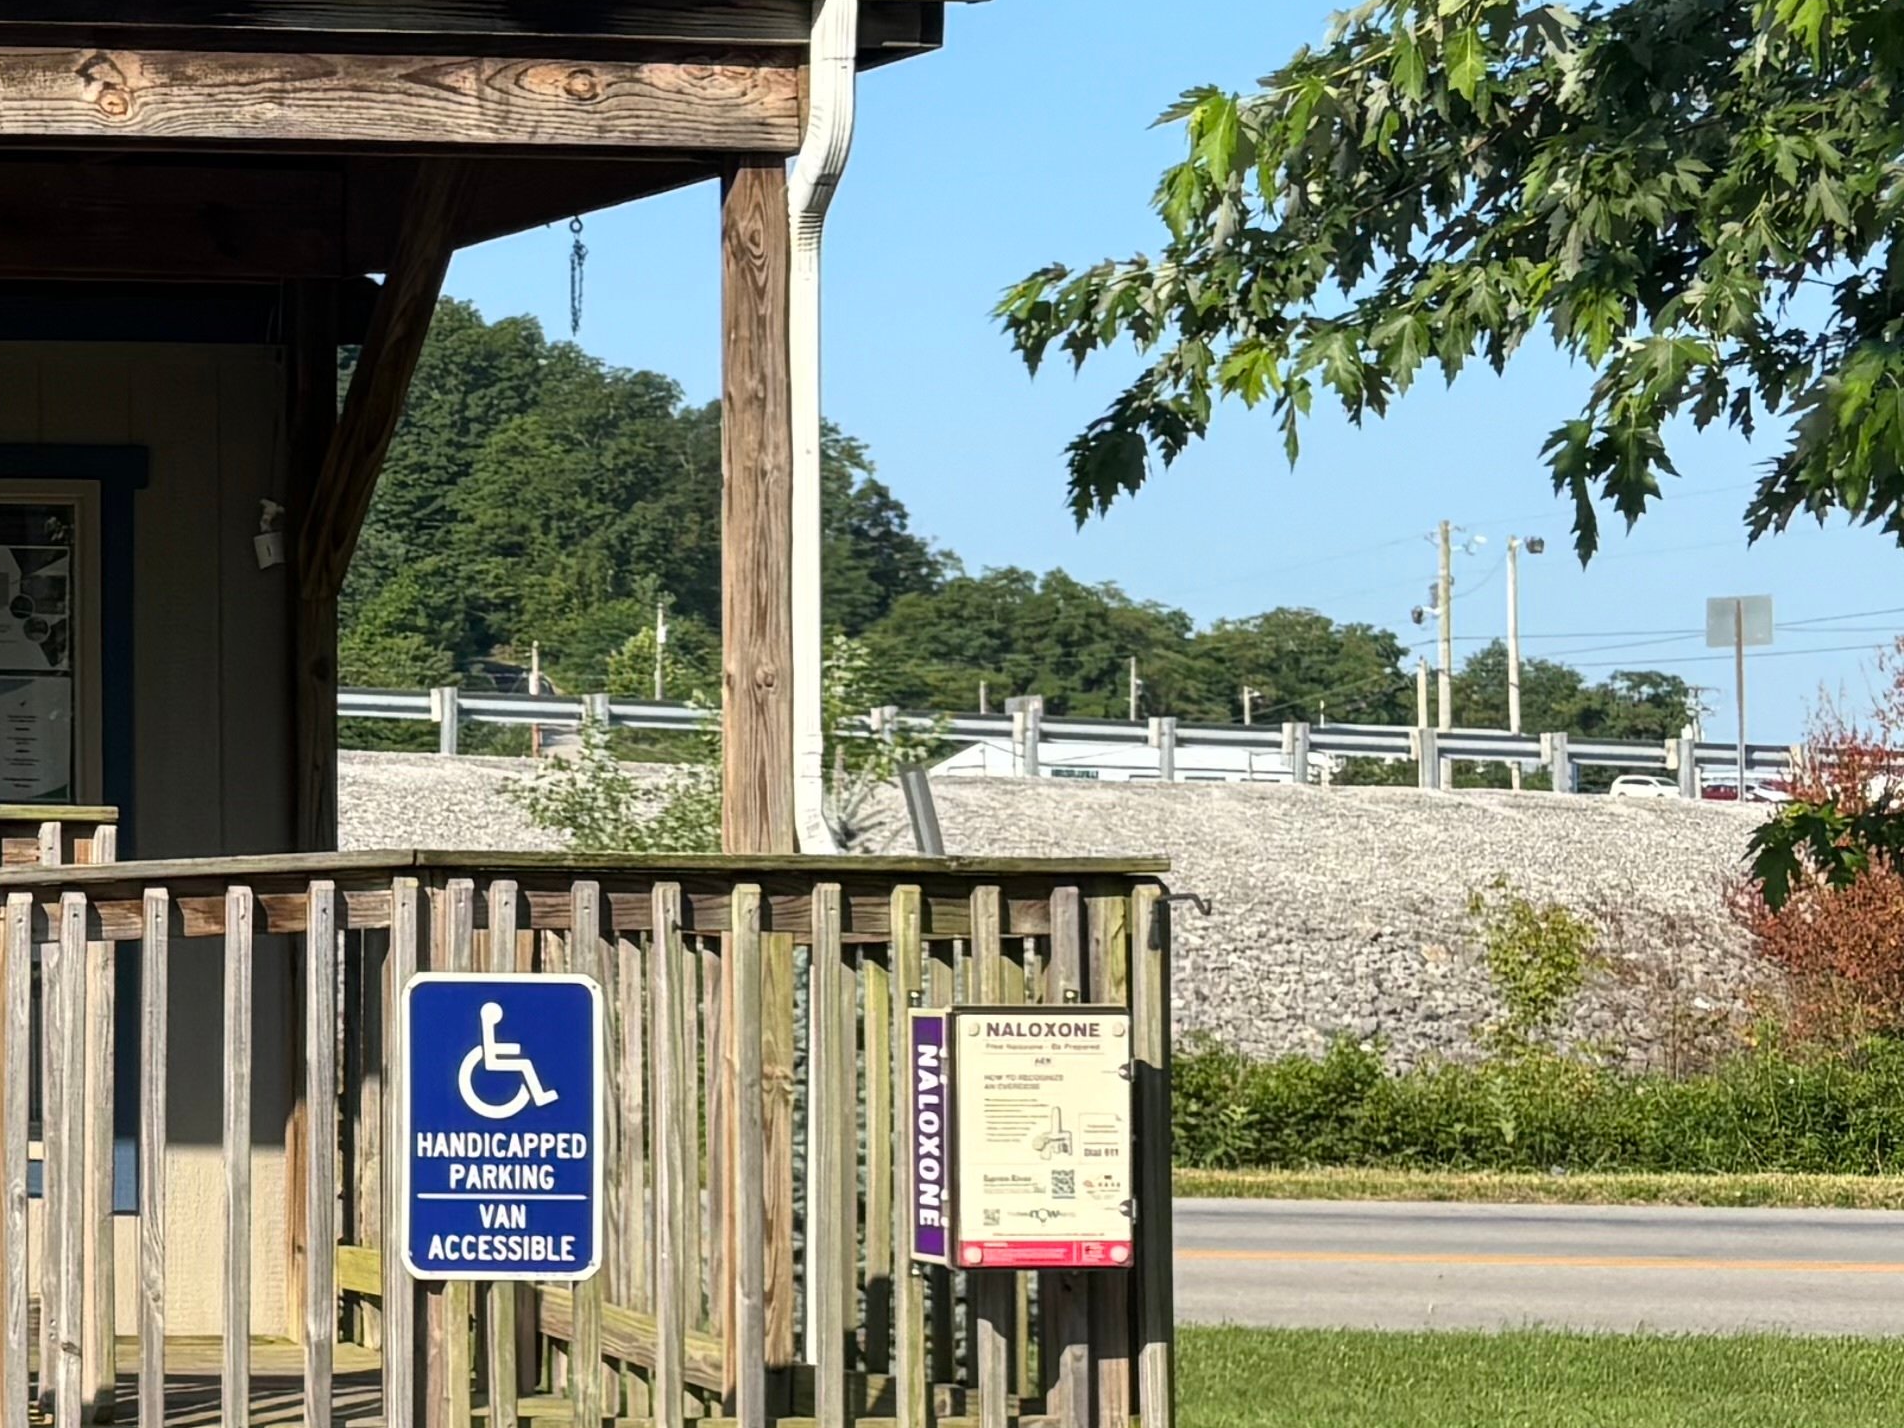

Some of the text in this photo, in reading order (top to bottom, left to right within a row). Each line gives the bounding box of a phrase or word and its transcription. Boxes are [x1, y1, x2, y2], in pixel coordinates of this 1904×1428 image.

[985, 1022, 1102, 1038] NALOXONE
[416, 1132, 587, 1159] HANDICAPPED
[917, 1043, 941, 1227] NALOXONE
[449, 1163, 555, 1190] PARKING
[478, 1203, 527, 1230] VAN
[427, 1234, 576, 1262] ACCESSIBLE
